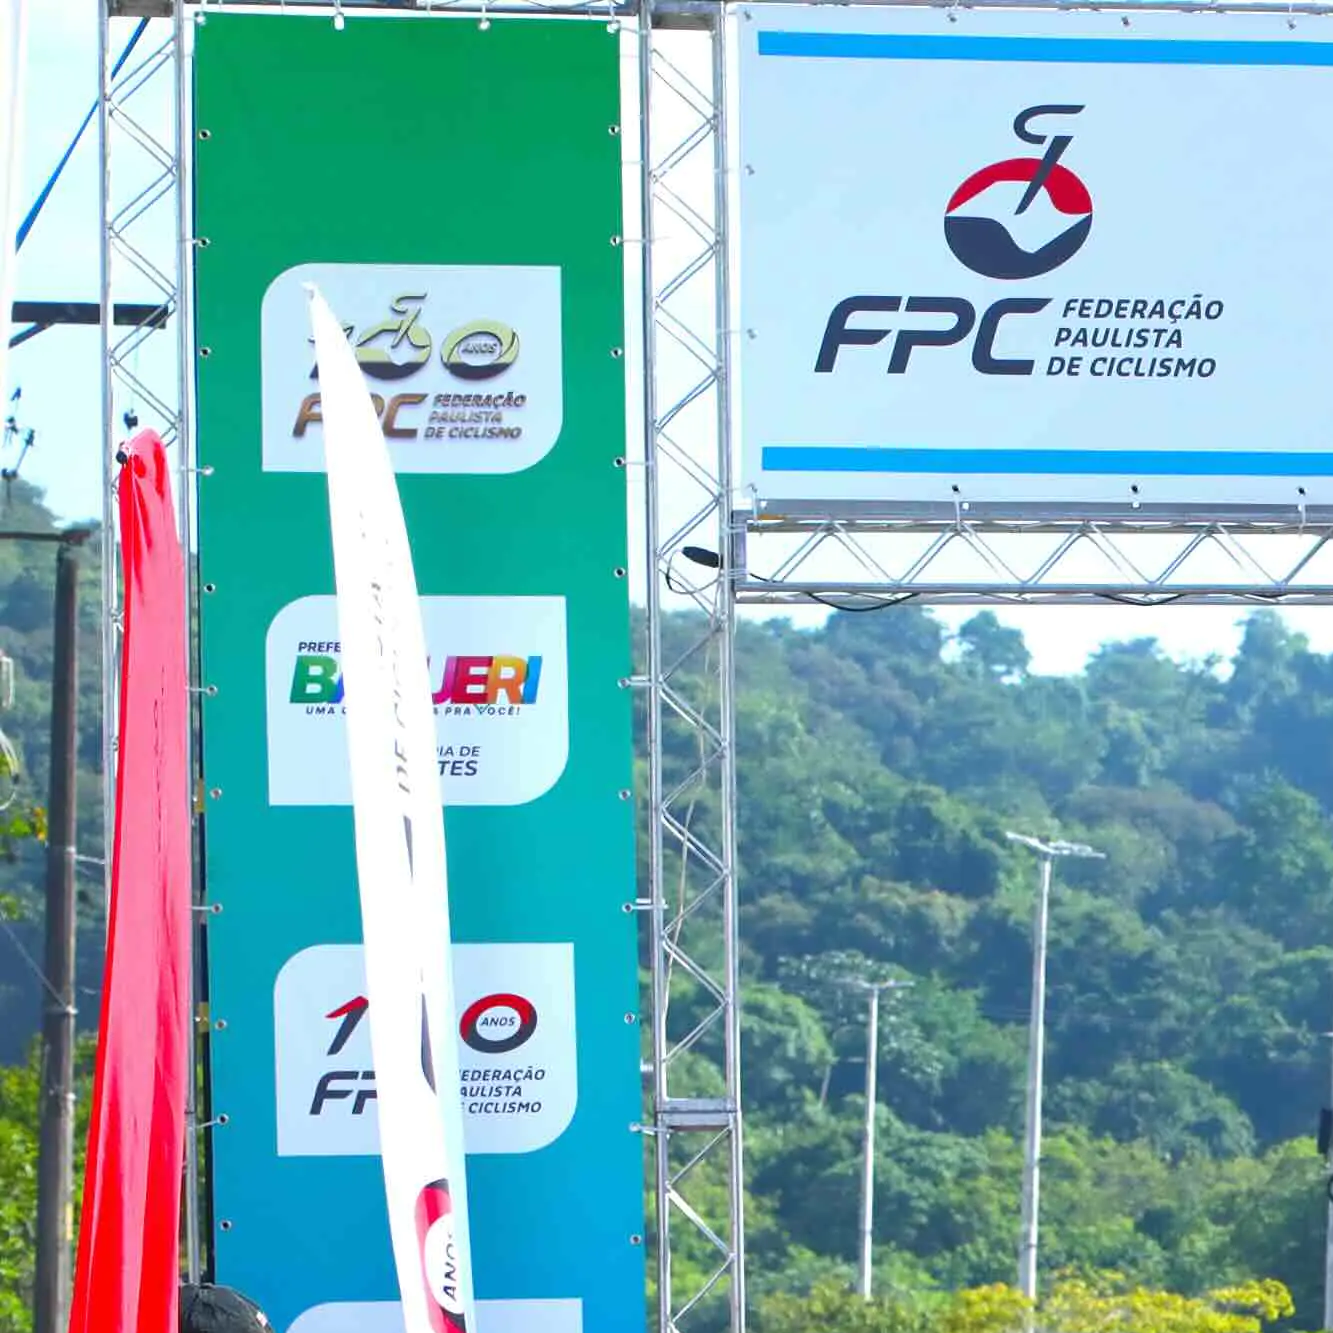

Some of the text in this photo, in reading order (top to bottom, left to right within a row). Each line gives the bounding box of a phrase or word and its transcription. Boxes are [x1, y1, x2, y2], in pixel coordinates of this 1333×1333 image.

[1062, 294, 1224, 324] FEDERAÇÃO
[814, 295, 1053, 375] FPC
[1054, 327, 1184, 350] PAULISTA
[1046, 356, 1217, 378] DE CICLISMO
[433, 391, 527, 409] FEDERAÇÃO
[428, 411, 504, 423] PAULISTA
[424, 426, 522, 441] DE CICLISMO
[305, 706, 336, 716] UMA
[445, 706, 472, 716] PRA
[459, 745, 481, 757] DE
[480, 1016, 516, 1027] ANOS
[459, 1065, 546, 1083] EDERAÇÃO
[460, 1085, 522, 1098] AULISTA
[468, 1101, 543, 1115] CICLISMO
